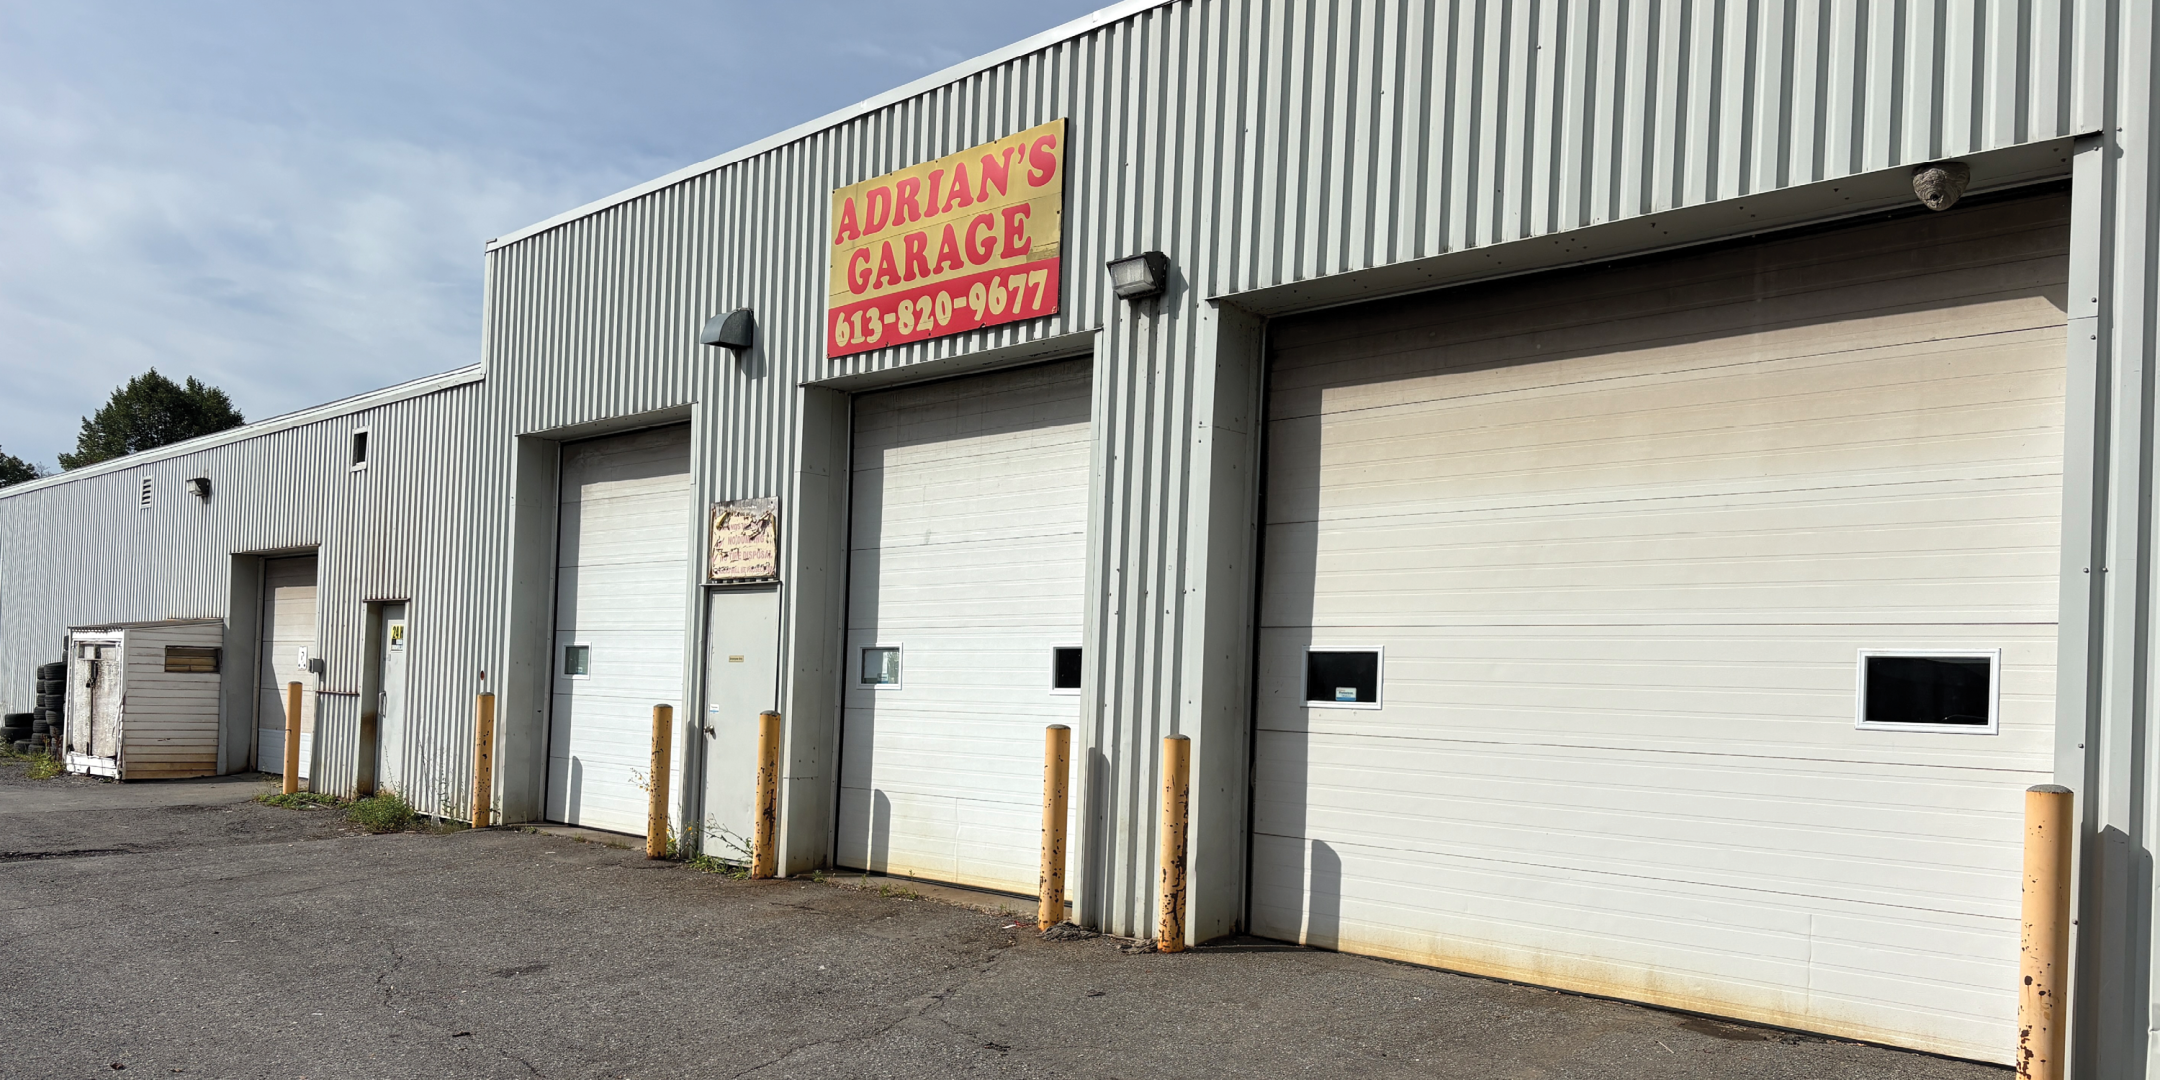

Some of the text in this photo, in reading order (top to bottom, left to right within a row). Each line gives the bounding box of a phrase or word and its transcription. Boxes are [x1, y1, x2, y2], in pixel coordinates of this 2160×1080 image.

[834, 134, 1057, 245] ADRIAN'S
[847, 203, 1032, 295] GARAGE
[835, 269, 1048, 347] 613-820-9677
